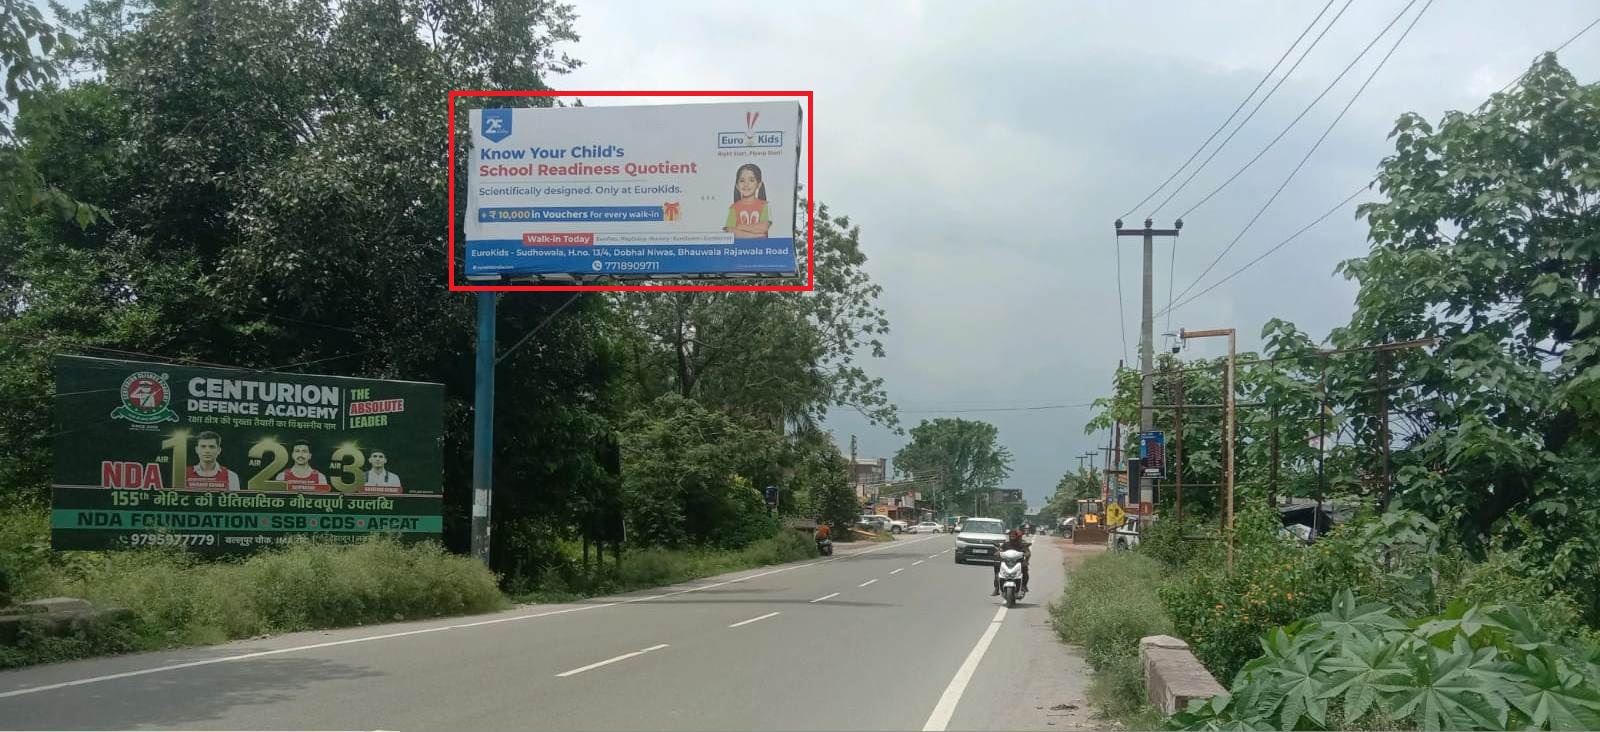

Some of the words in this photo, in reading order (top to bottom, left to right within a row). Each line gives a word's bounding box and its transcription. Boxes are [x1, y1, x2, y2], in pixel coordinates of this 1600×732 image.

[722, 136, 744, 144] Euro
[758, 134, 779, 144] Kids
[480, 148, 526, 160] Know
[530, 147, 566, 159] Your
[571, 145, 625, 158] Child's
[480, 164, 532, 176] School
[538, 162, 620, 176] Readiness
[624, 160, 698, 176] Quotient
[479, 186, 542, 197] Scientifically
[544, 186, 593, 196] designed.
[596, 185, 618, 196] Only
[622, 186, 631, 194] at
[634, 184, 682, 194] EuroKids.
[498, 210, 530, 220] 10,000
[532, 210, 540, 219] in
[543, 210, 588, 219] Vouchers
[590, 210, 602, 218] for
[604, 211, 627, 220] every
[629, 210, 660, 218] walk-in
[528, 235, 562, 243] Walk-in
[564, 235, 590, 244] Today
[472, 249, 509, 257] EuroKids
[516, 248, 566, 258] Sudhowala,
[568, 249, 590, 257] H.no.
[593, 248, 611, 258] 13/4,
[614, 248, 644, 256] Dobhal
[648, 248, 675, 257] Niwas,
[678, 248, 721, 256] Bhauwala
[724, 248, 763, 257] Rajawala
[604, 261, 660, 270] 7718909711
[188, 377, 339, 406] CENTURION
[350, 388, 370, 400] THE
[188, 399, 259, 415] DEFENCE
[264, 403, 338, 420] ACADEMY
[351, 400, 403, 415] ABSOLUTE
[220, 415, 230, 425] की
[254, 417, 274, 428] तैयारी
[276, 420, 286, 428] का
[350, 415, 388, 428] LEADER
[162, 432, 188, 489] 1
[248, 459, 262, 467] AIR
[248, 438, 288, 490] 2
[330, 462, 342, 470] AIR
[330, 442, 365, 492] 3
[102, 461, 164, 490] NDA
[111, 491, 149, 506] 155th
[154, 490, 190, 506] मेरिट
[195, 492, 212, 507] की
[218, 493, 285, 508] ऐतिहासिक
[290, 494, 344, 512] गौरवपूर्ण
[348, 496, 394, 510] उपलब्धि
[78, 512, 122, 527] NDA
[131, 514, 259, 528] FOUNDATION
[271, 516, 308, 529] SSB
[320, 517, 356, 530] CDS
[368, 518, 419, 530] AFCAT
[131, 534, 214, 546] 9795977779
